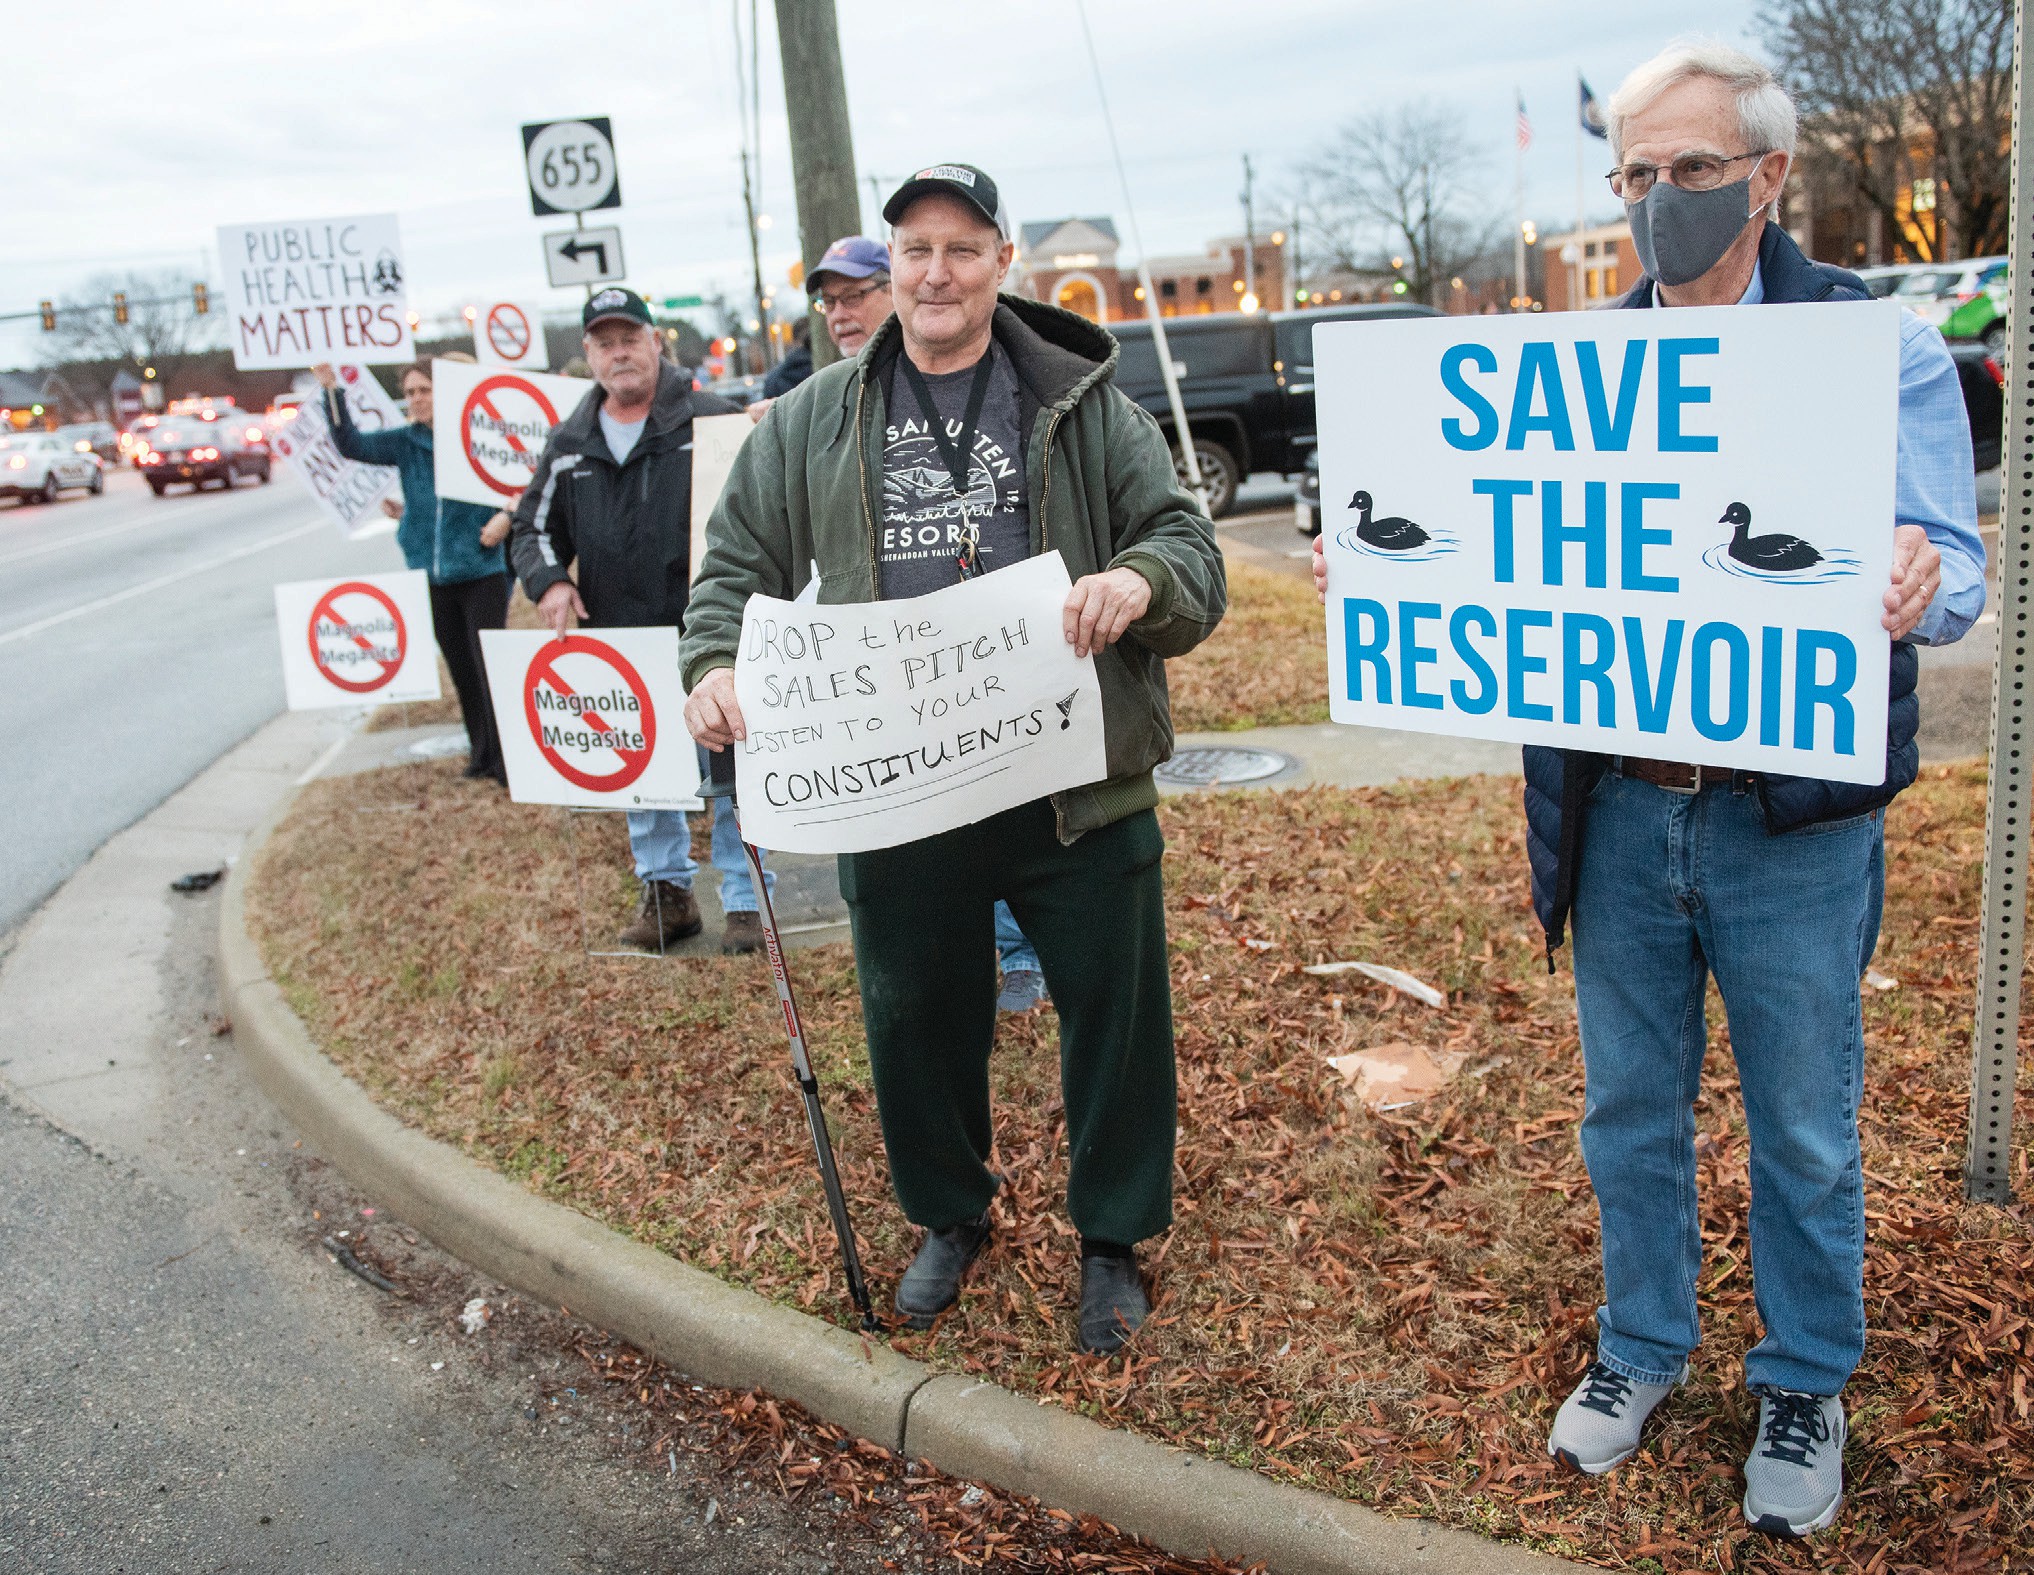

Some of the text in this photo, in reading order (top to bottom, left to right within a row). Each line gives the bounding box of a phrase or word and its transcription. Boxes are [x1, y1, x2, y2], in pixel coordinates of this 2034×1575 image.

[542, 142, 602, 188] 655
[245, 225, 362, 263] PUBLIC
[241, 261, 370, 307] HEALTH
[239, 304, 402, 356] MATTERS
[1440, 337, 1720, 452] SAVE
[880, 550, 928, 562] SHENANDOAH
[883, 523, 980, 549] ESORT
[1472, 478, 1681, 593] THE
[316, 617, 396, 641] Magnolia
[747, 618, 942, 664] DROP the
[319, 644, 400, 667] Megasite
[763, 618, 1029, 708] SALES PITCH
[1343, 597, 1857, 756] RESERVOIR
[534, 688, 640, 717] Magnolia
[745, 675, 1006, 754] LISTEN TO YOUR
[542, 725, 645, 753] Megasite
[763, 927, 785, 982] Activator
